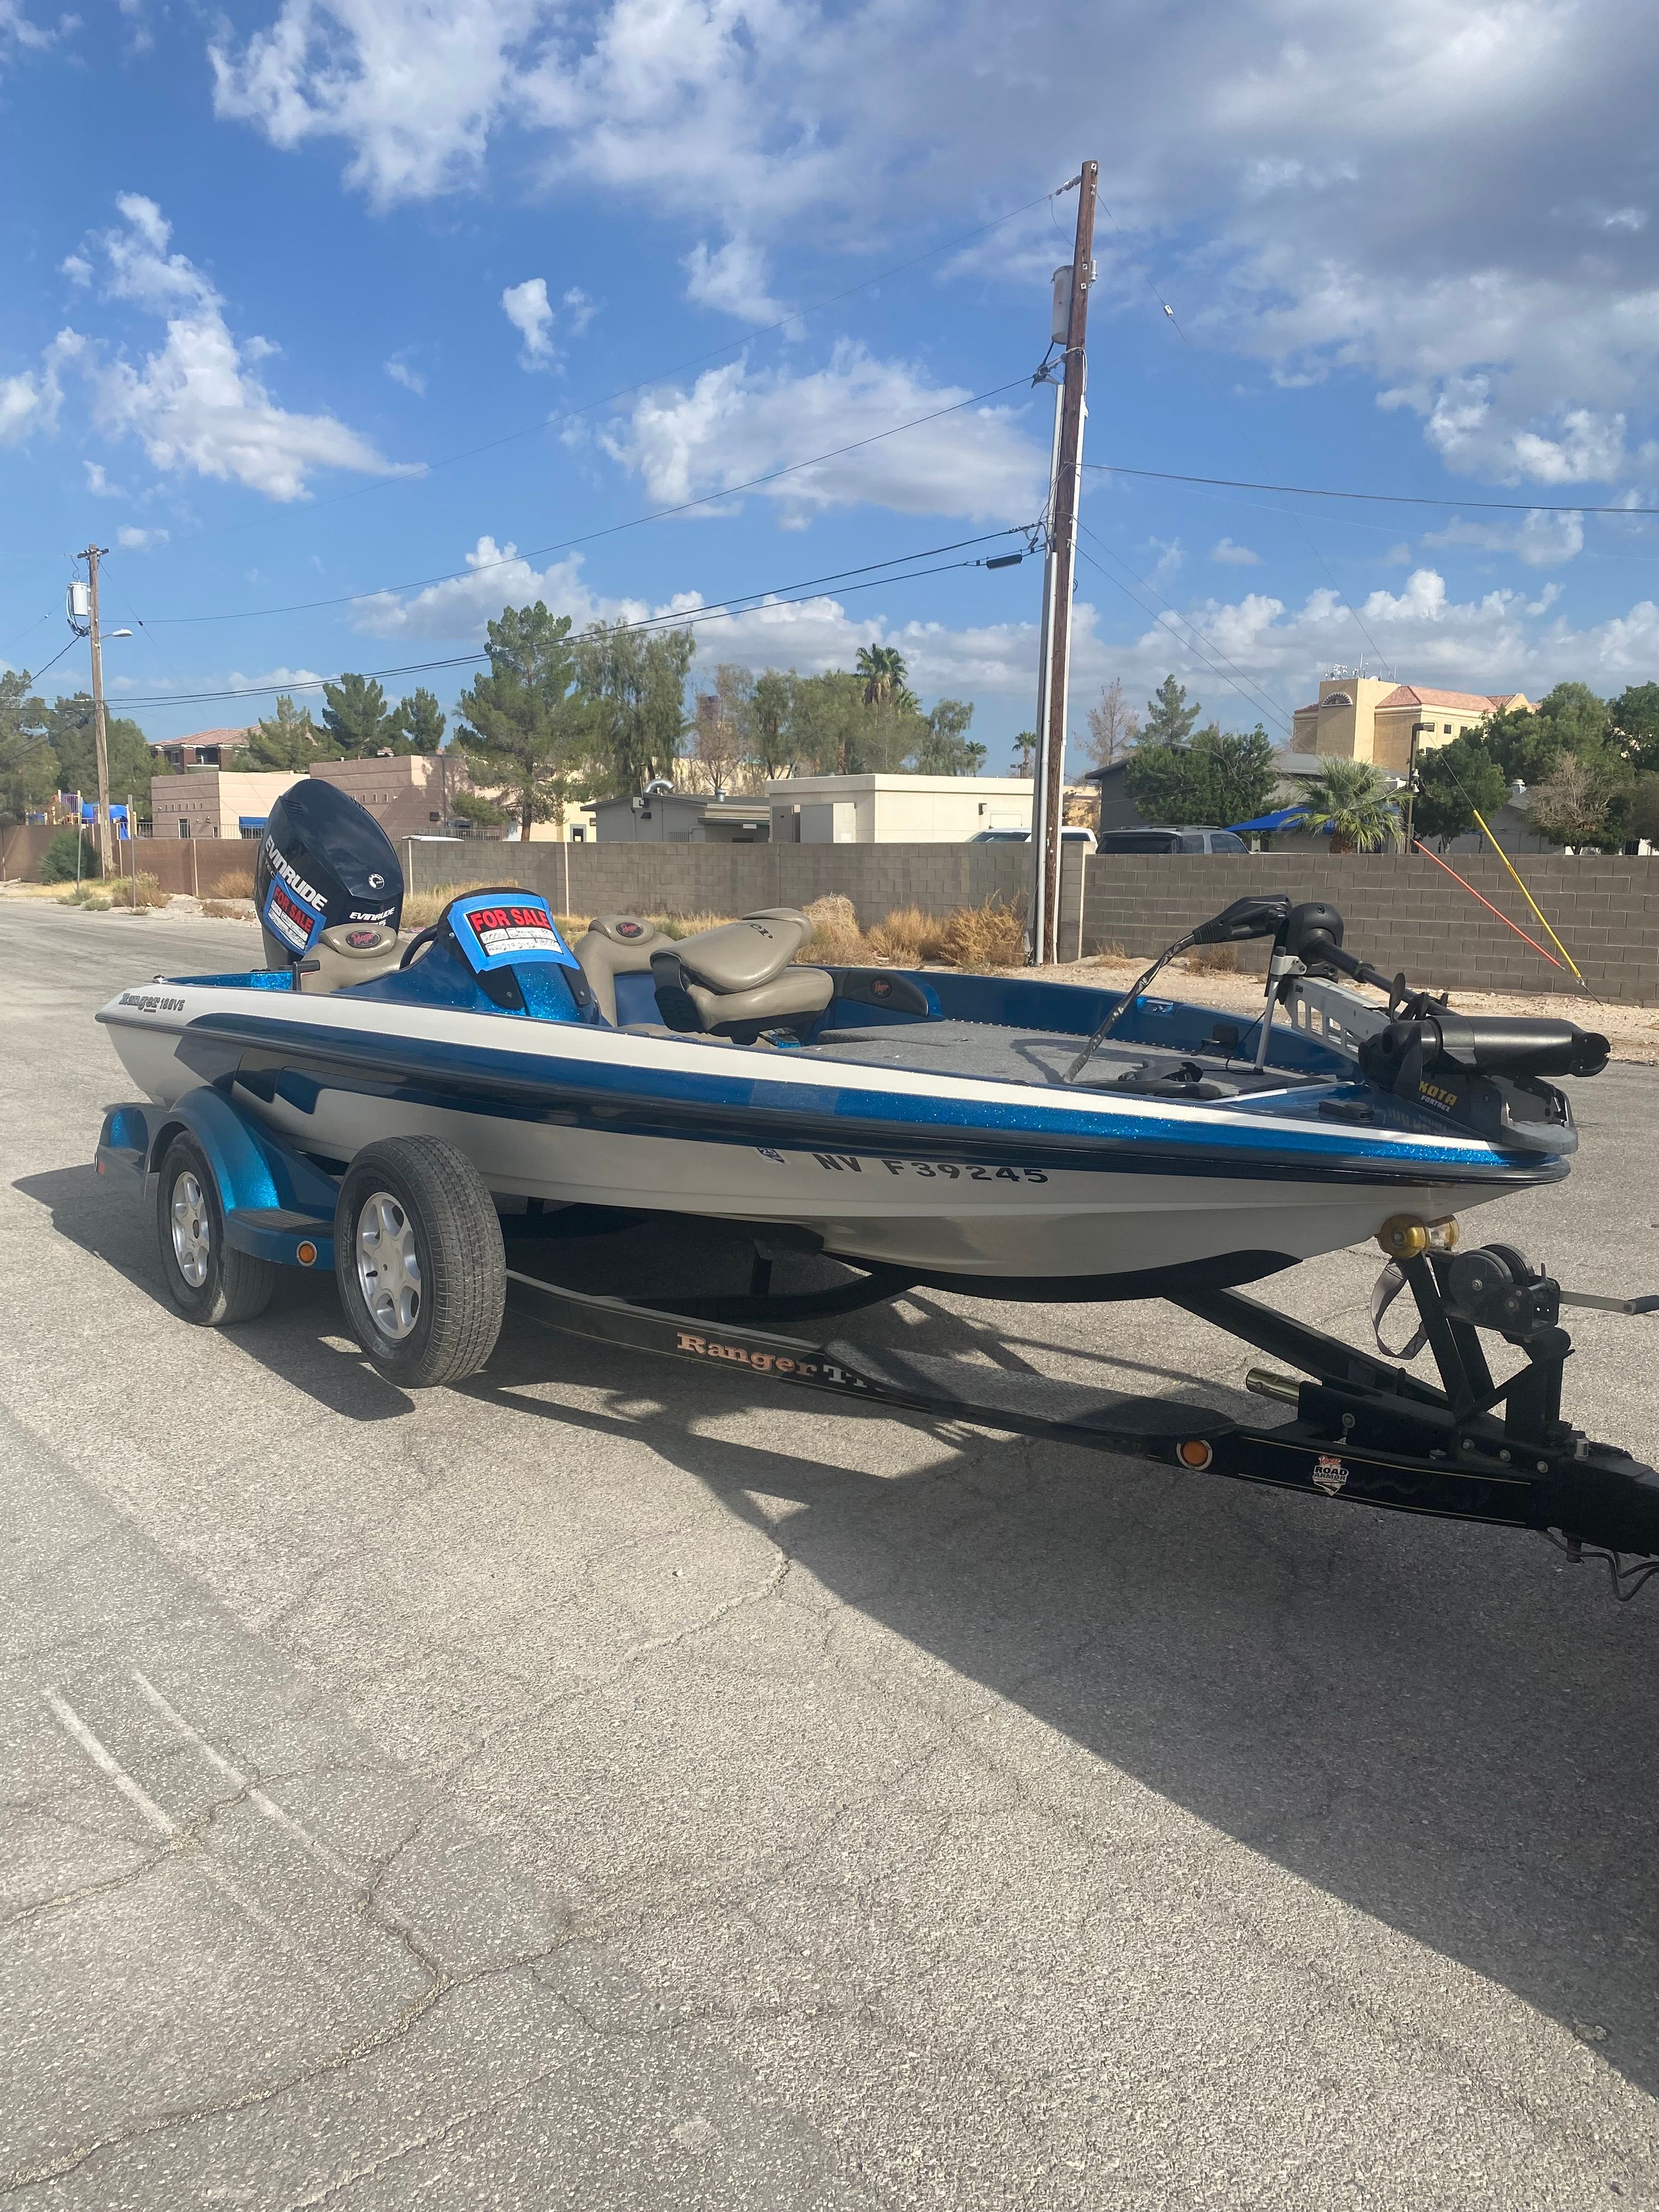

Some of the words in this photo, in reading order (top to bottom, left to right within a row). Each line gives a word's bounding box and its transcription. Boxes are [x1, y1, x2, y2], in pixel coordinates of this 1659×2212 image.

[266, 834, 328, 912] EVINRUDE
[274, 885, 290, 912] FOR
[289, 904, 313, 934] SALE
[349, 907, 395, 921] EVINRUDE
[470, 909, 511, 932] FOR
[510, 909, 551, 929] SALE
[119, 993, 161, 1009] Ranger
[160, 998, 185, 1011] 188VS
[1419, 1080, 1458, 1106] KOTA
[1421, 1095, 1452, 1113] FORTREX
[812, 1153, 862, 1172] NV
[881, 1159, 1048, 1183] F39245
[676, 1332, 817, 1378] Ranger
[1315, 1466, 1348, 1476] ROAD
